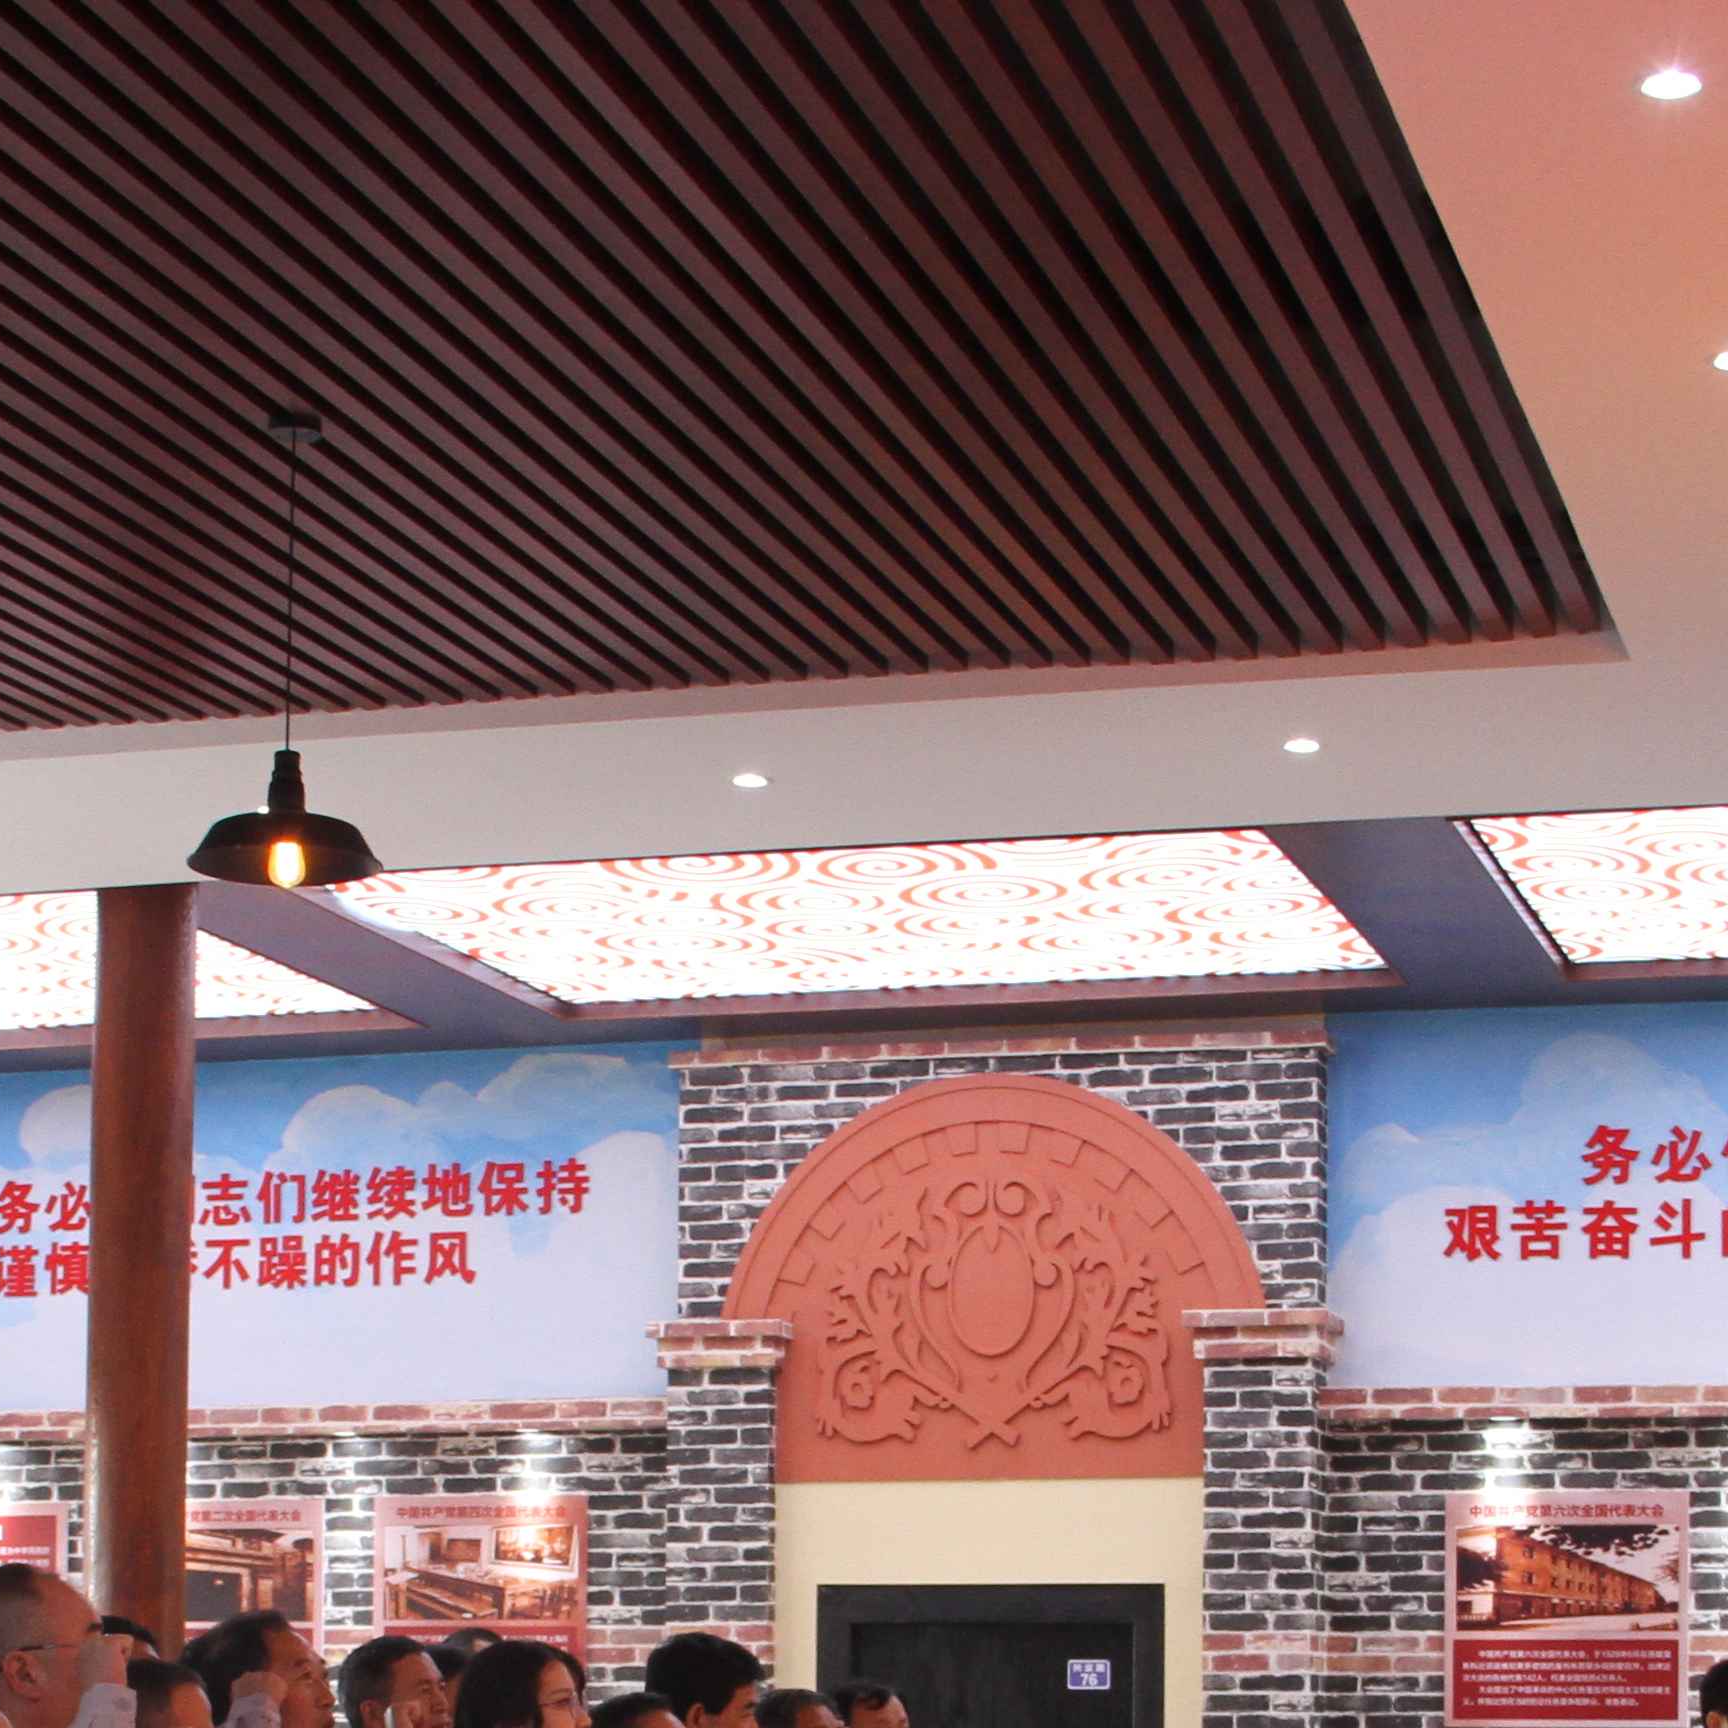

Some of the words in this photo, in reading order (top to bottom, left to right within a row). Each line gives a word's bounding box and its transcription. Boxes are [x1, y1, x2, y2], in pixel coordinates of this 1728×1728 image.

[1470, 1504, 1665, 1518] 中国共产党第六次全国代表大会
[1080, 1673, 1099, 1686] 76
